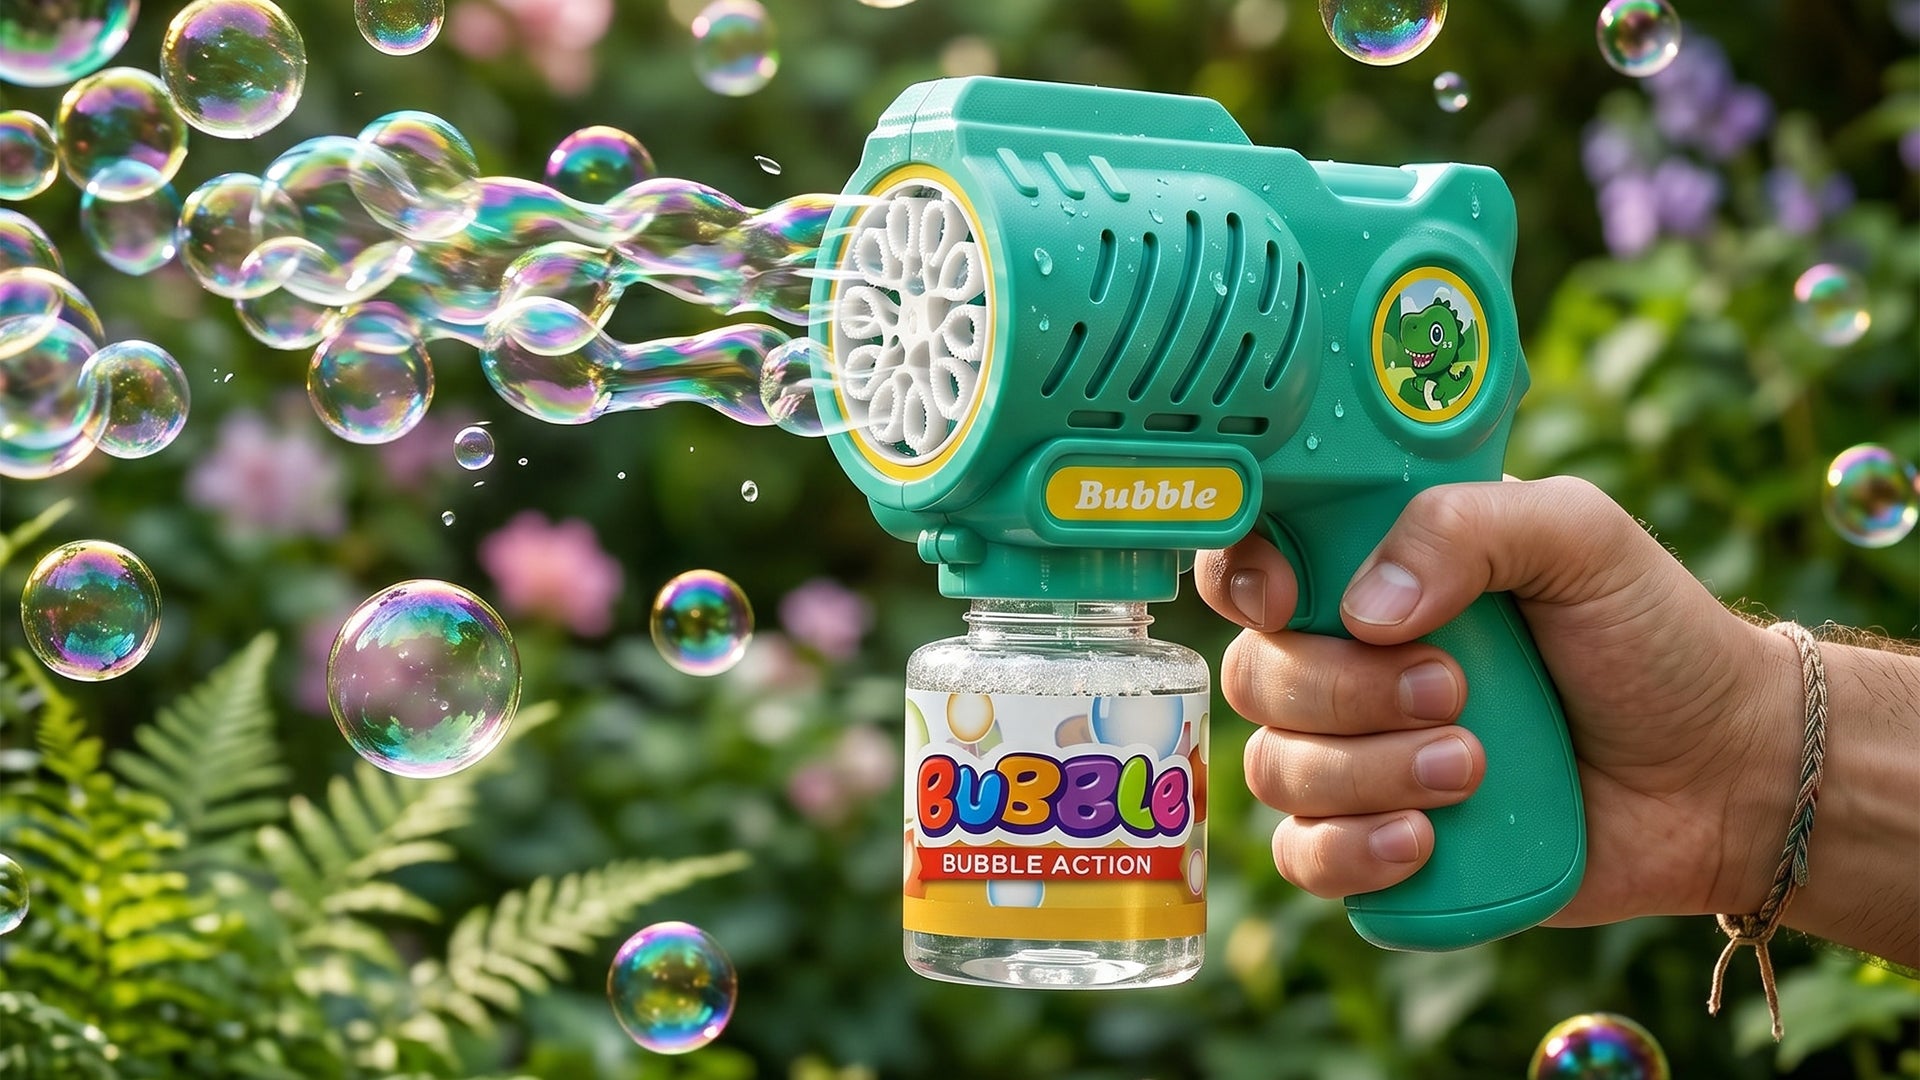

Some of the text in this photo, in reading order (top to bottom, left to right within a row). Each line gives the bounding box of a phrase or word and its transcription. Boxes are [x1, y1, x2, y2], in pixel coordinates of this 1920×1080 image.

[1074, 480, 1218, 510] Bubble
[942, 854, 1152, 875] BUBBLE ACTION
